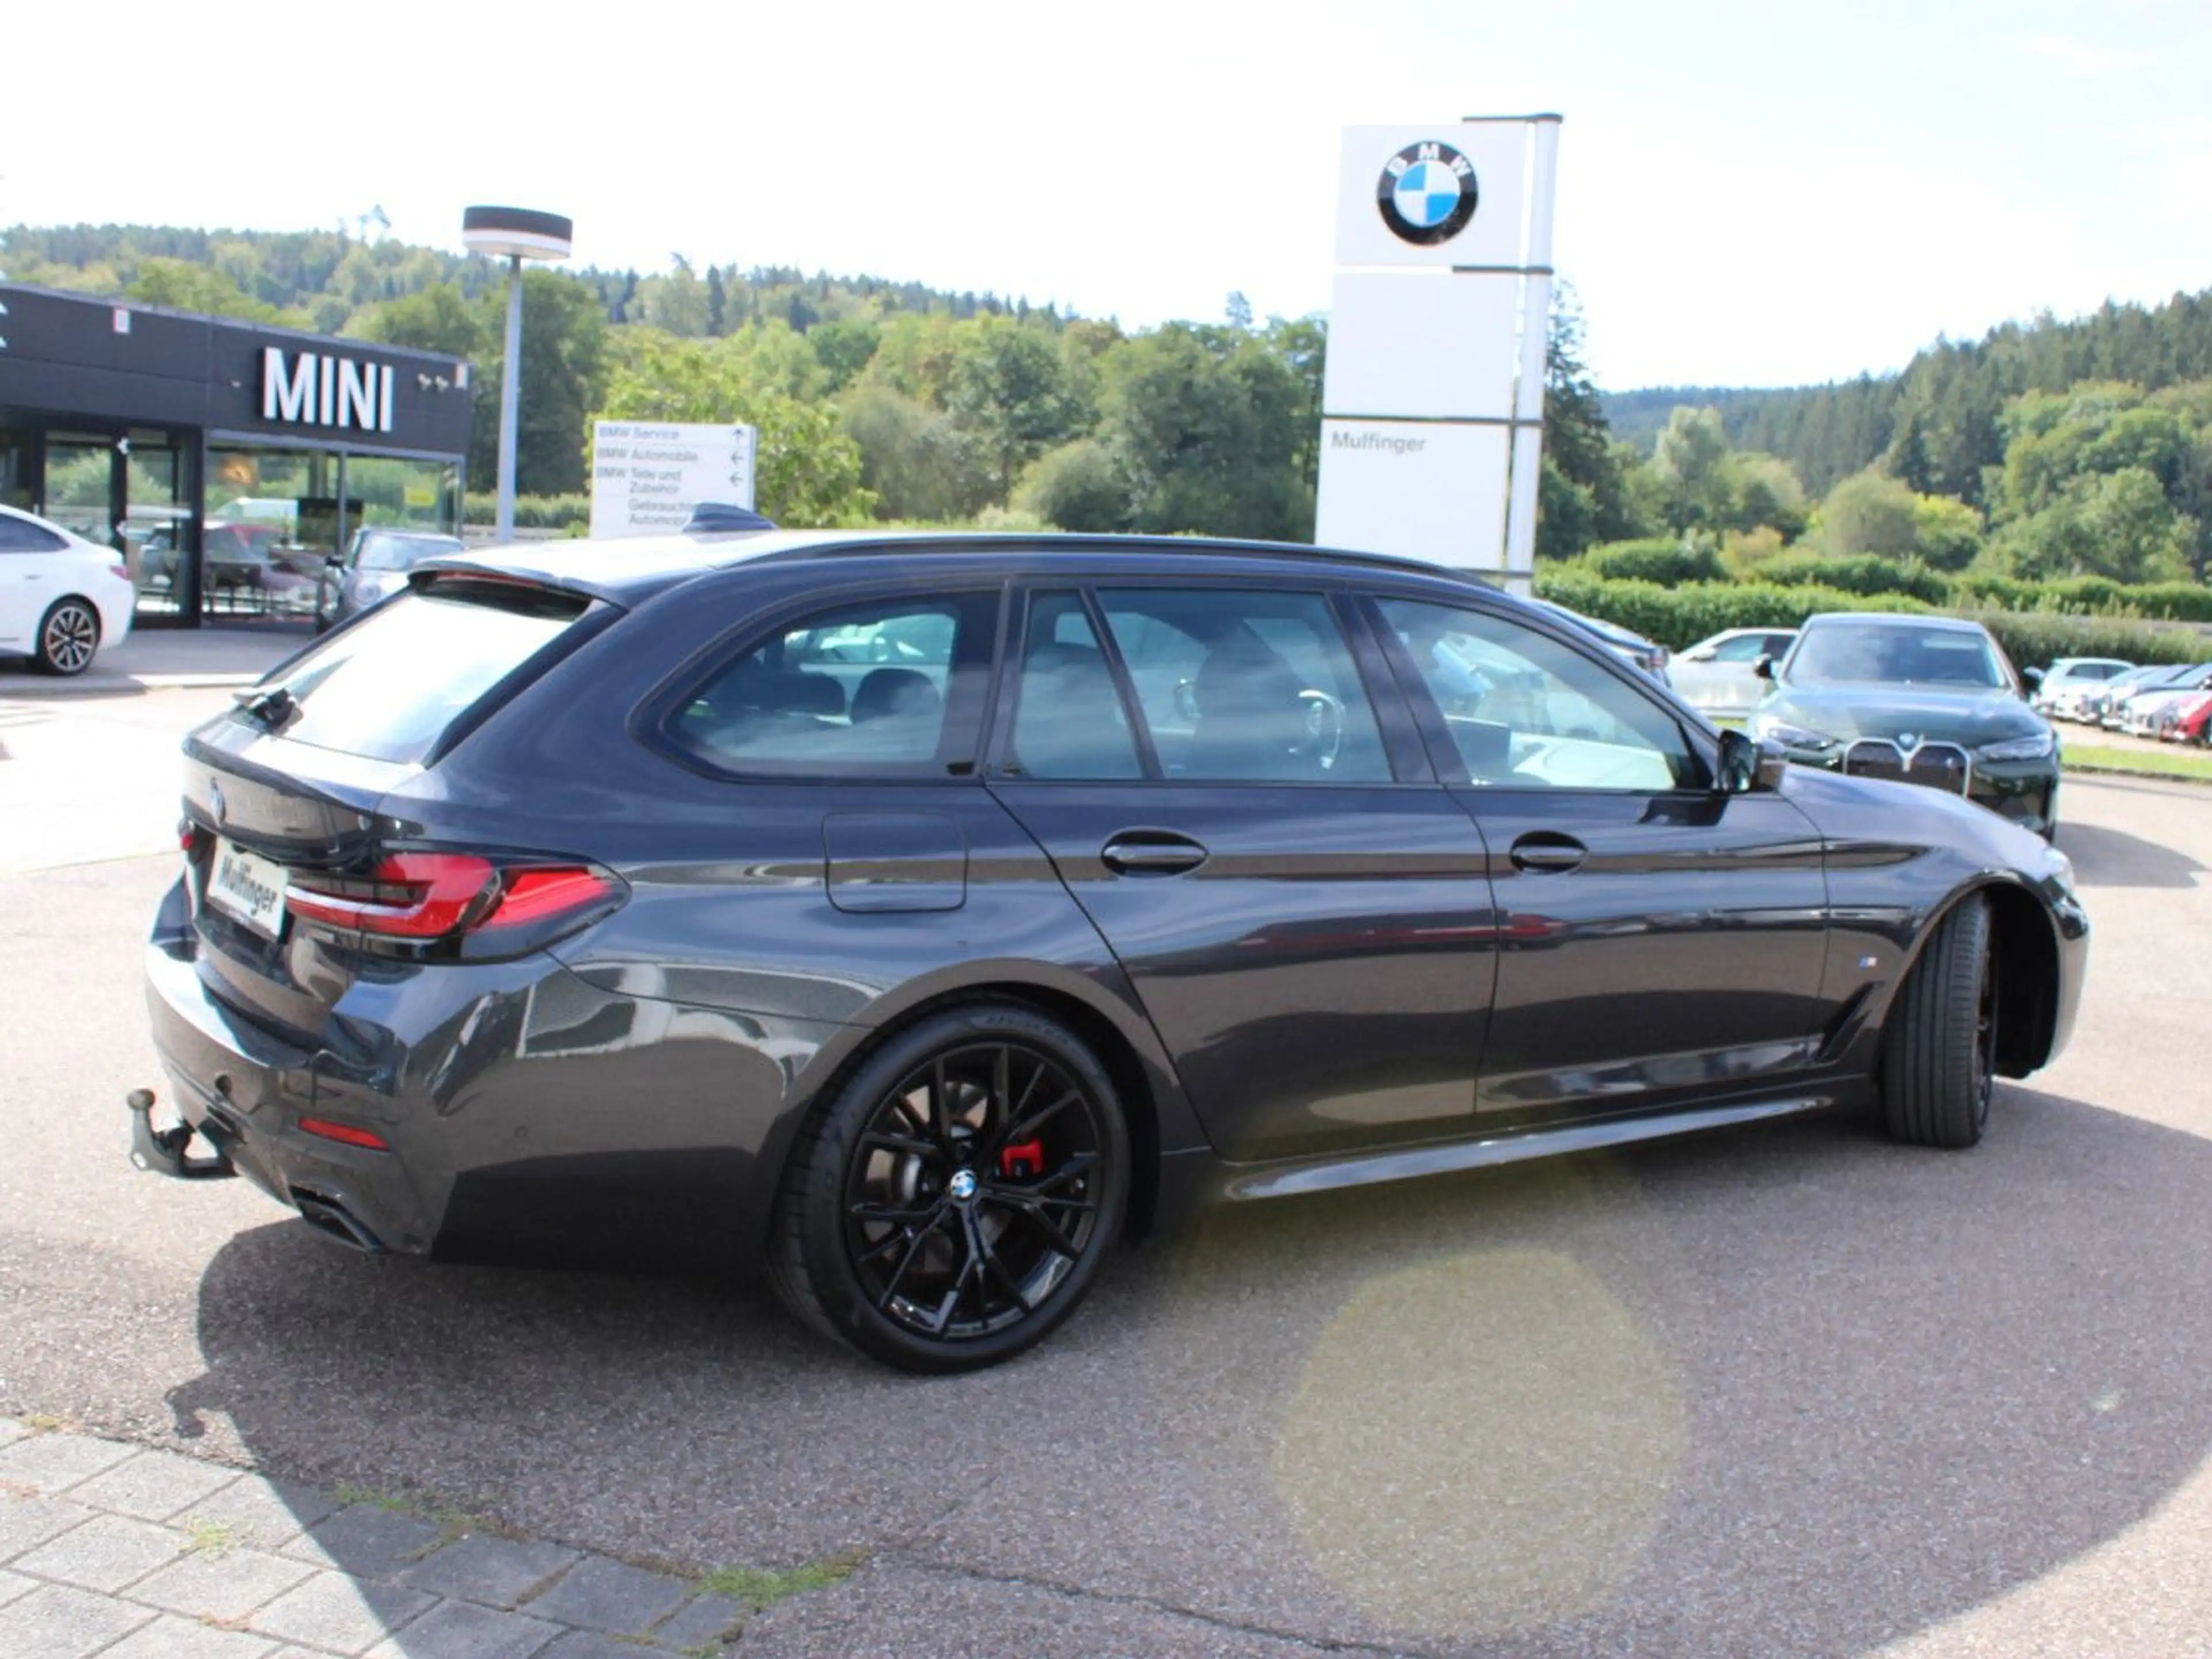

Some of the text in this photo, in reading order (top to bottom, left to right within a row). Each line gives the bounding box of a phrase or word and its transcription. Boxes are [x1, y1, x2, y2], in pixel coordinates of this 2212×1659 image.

[1387, 142, 1471, 175] BMW
[263, 346, 393, 432] MINI
[1332, 431, 1426, 454] Mulfinger
[219, 855, 277, 916] Mulfinger
